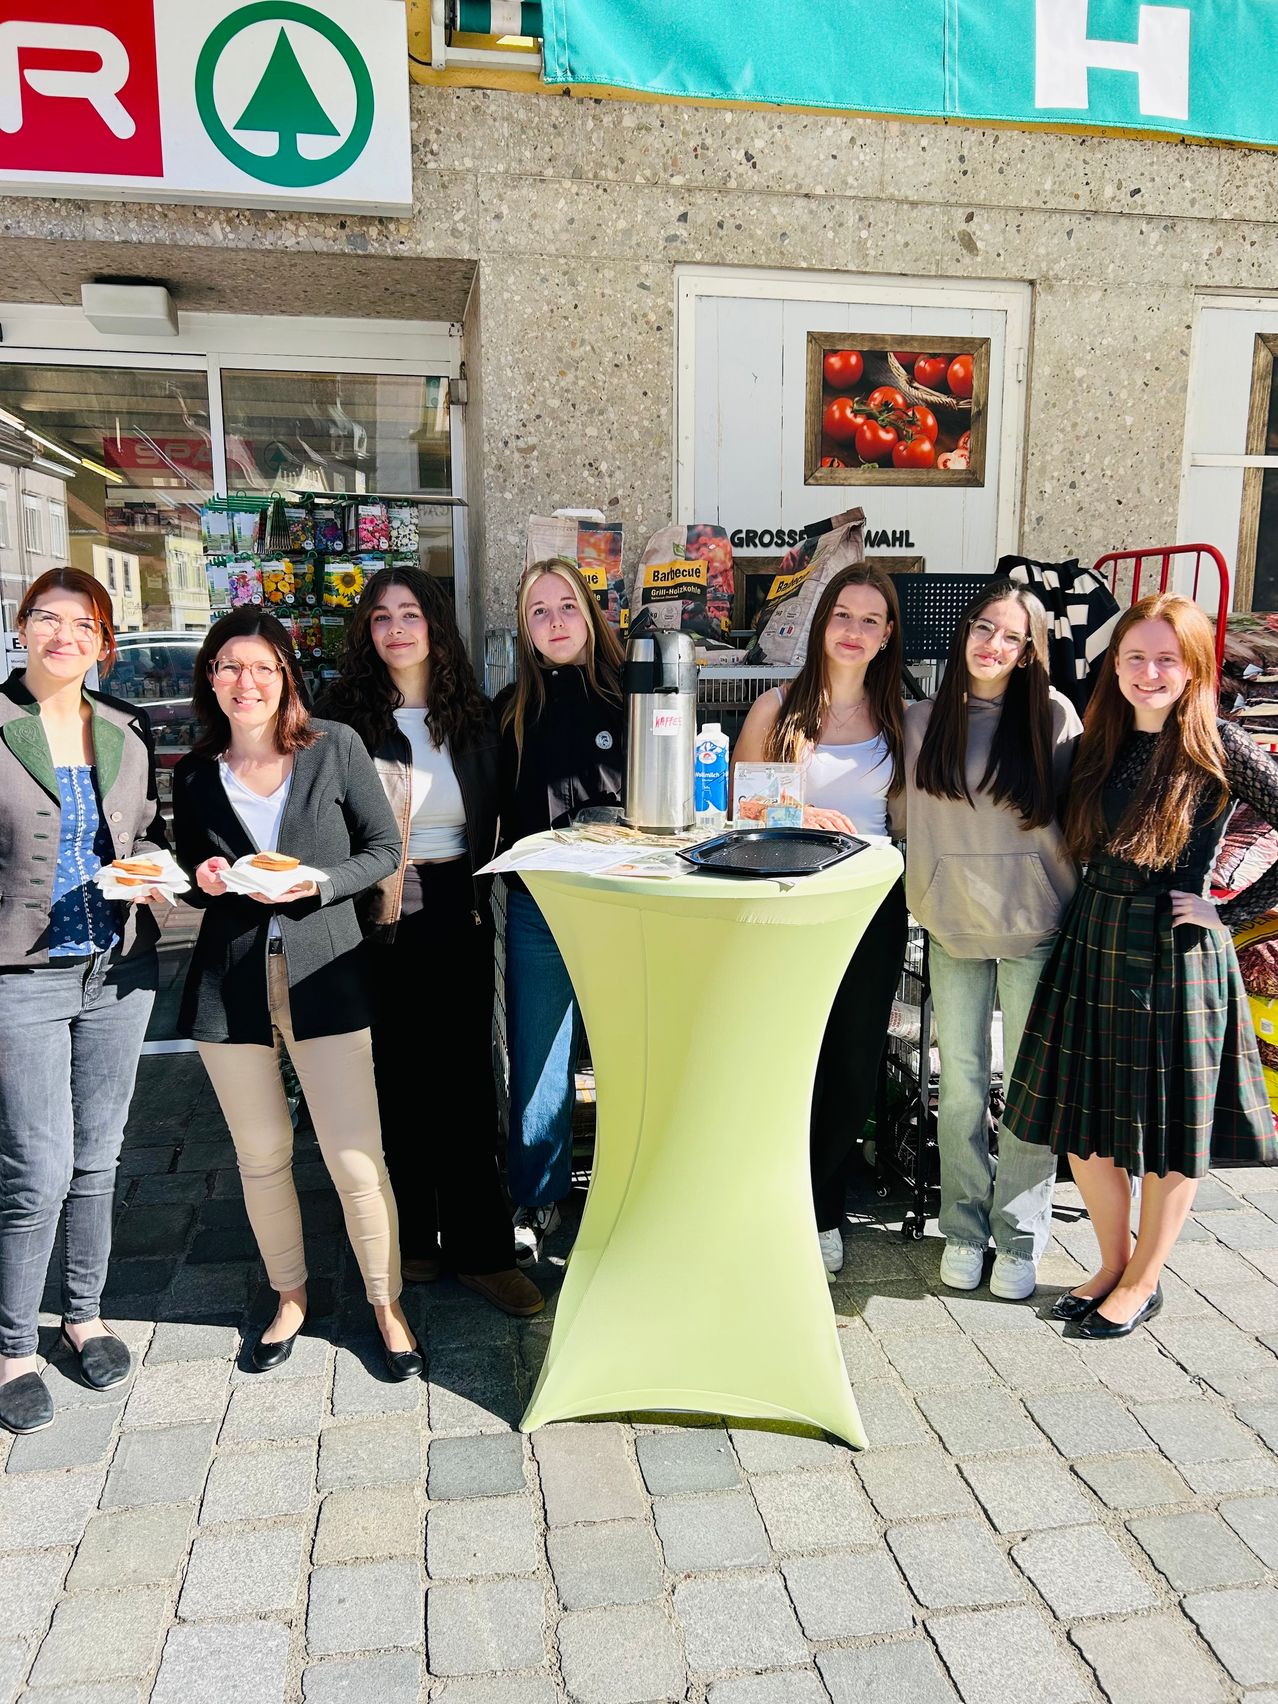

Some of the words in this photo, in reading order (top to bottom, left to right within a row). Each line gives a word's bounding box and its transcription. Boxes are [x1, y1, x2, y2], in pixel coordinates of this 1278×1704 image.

[1034, 0, 1190, 121] H
[0, 20, 137, 140] R
[864, 529, 915, 548] WAHL
[652, 566, 702, 582] Barbecue
[655, 714, 683, 729] KAFFEE
